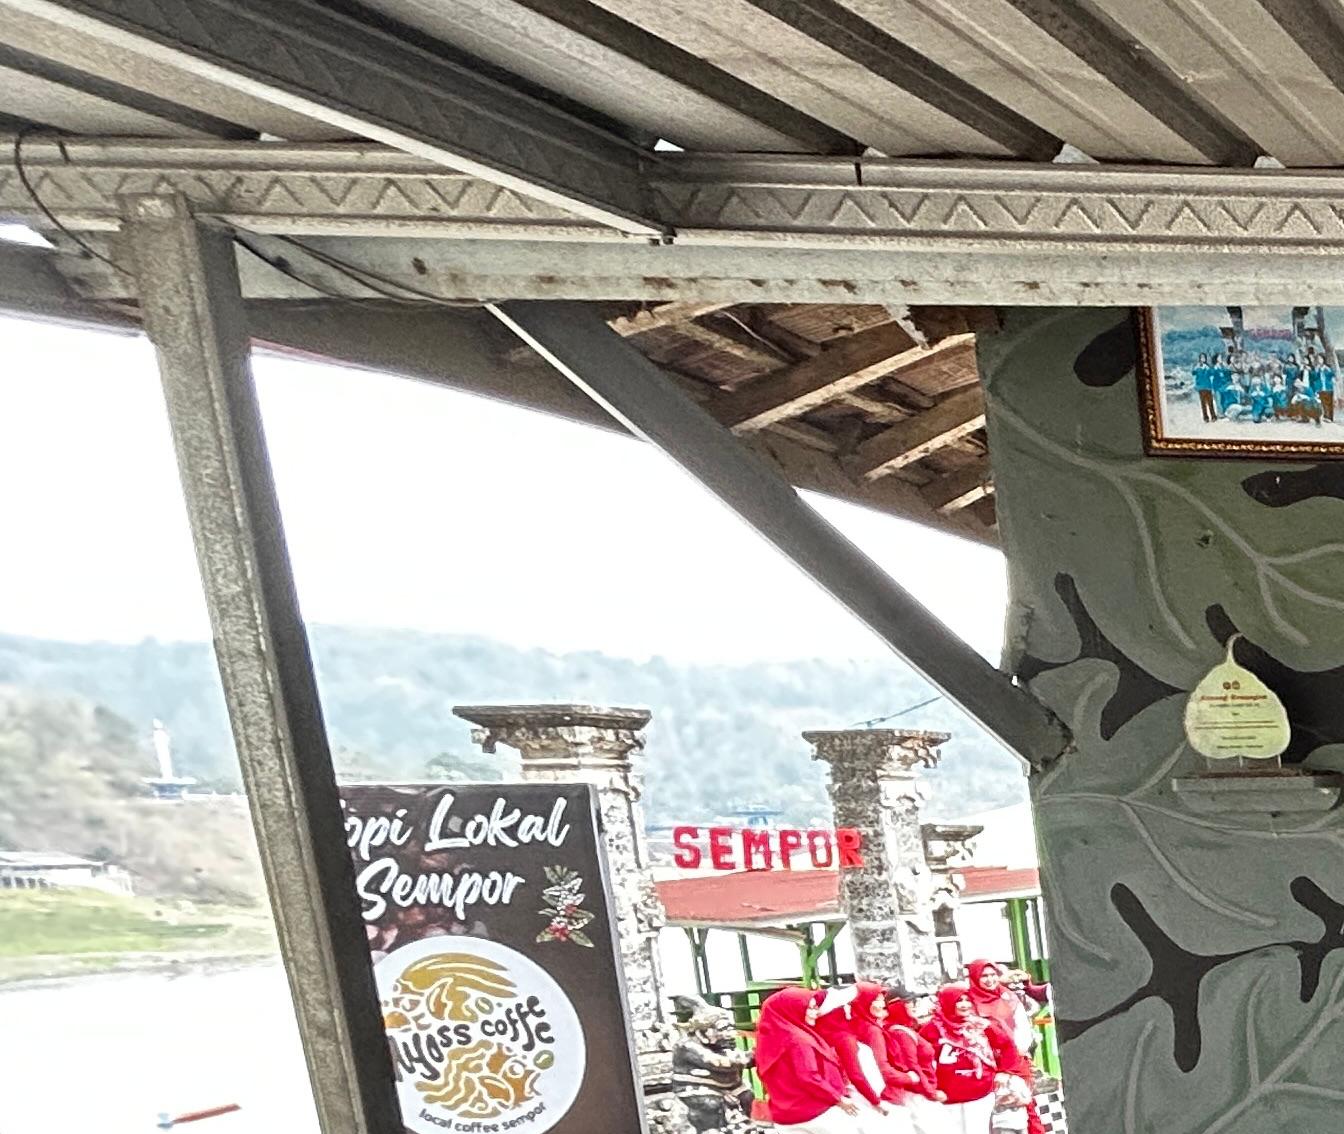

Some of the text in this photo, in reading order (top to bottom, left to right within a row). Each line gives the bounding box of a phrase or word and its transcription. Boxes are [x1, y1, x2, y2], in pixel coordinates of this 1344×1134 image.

[343, 793, 570, 861] opi Lokal
[673, 826, 865, 871] SEMPOR
[357, 857, 525, 921] Sempor
[419, 1101, 547, 1134] local coffee sempor
